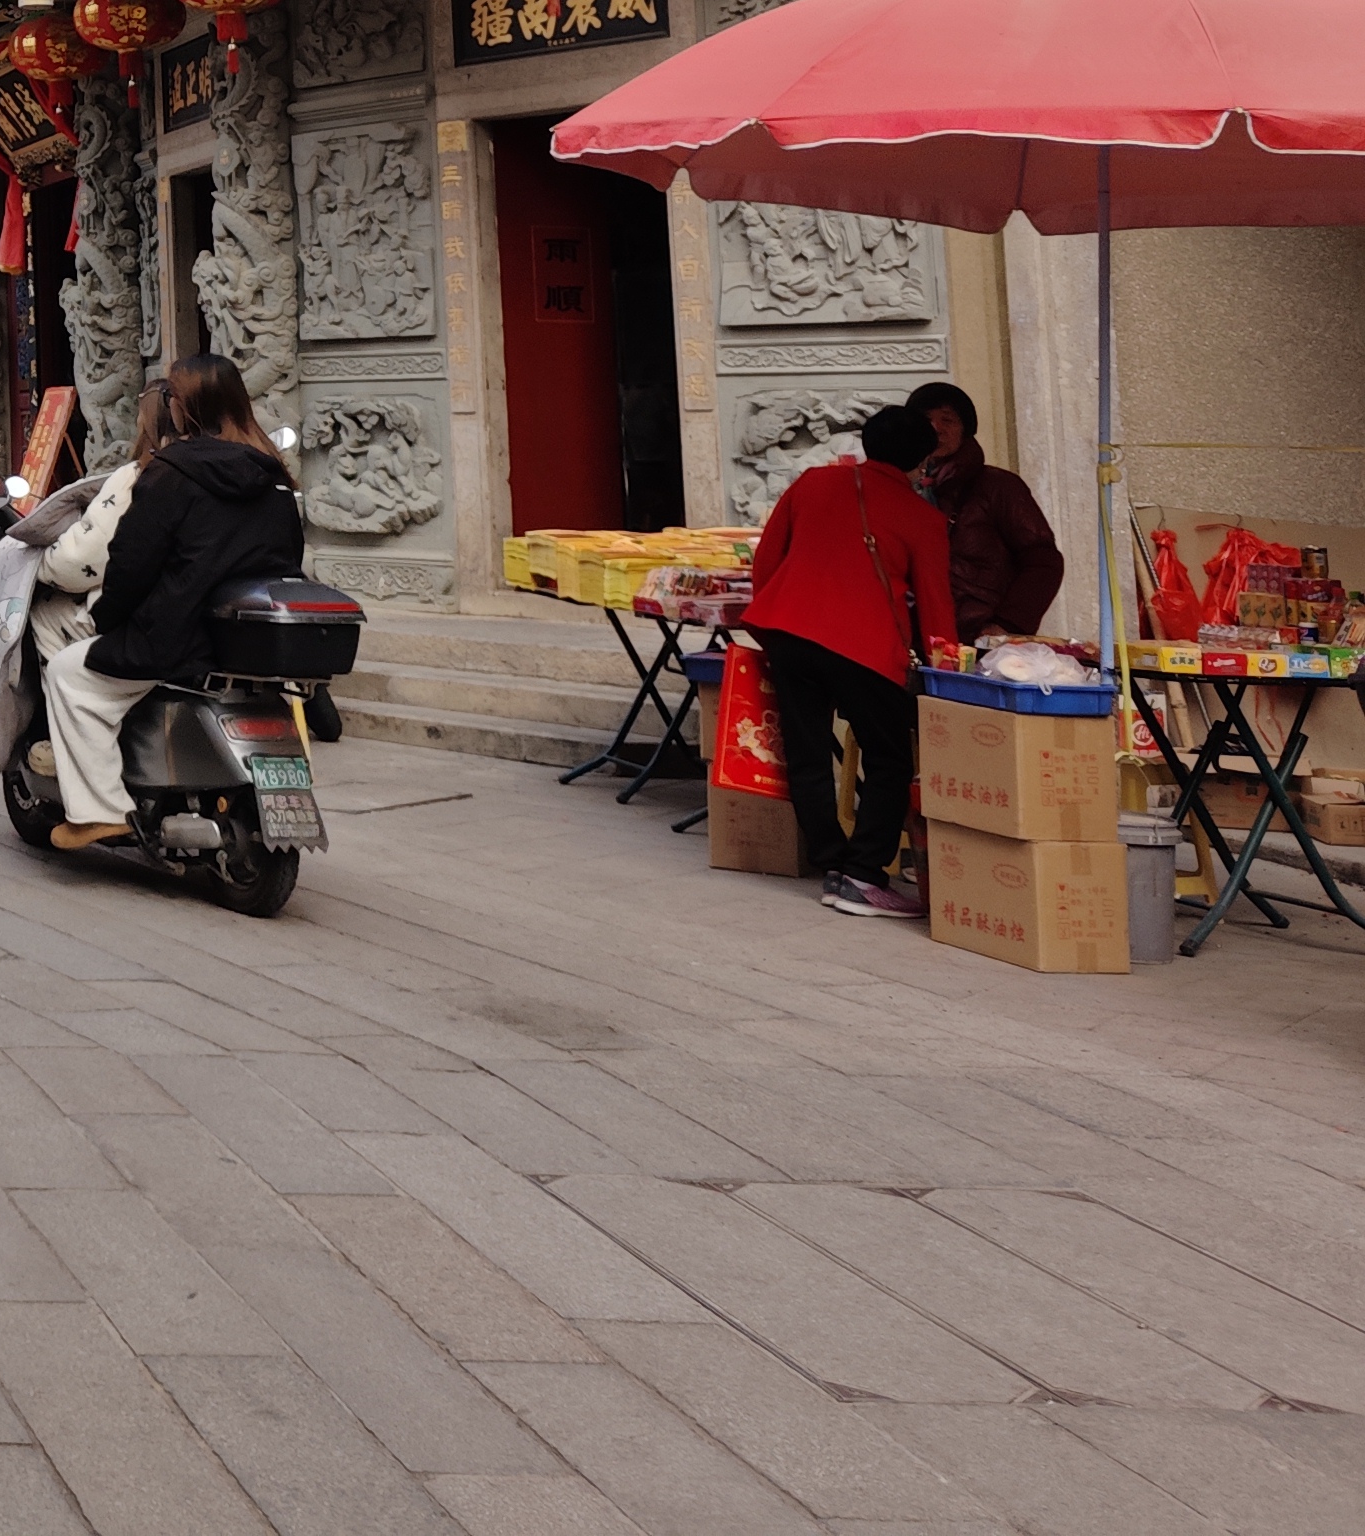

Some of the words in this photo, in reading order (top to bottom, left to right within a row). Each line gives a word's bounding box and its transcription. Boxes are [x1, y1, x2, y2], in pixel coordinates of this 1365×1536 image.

[543, 238, 584, 312] 雨順
[929, 772, 1009, 808] 精品酥油烛
[941, 900, 1025, 943] 精品酥油烛
